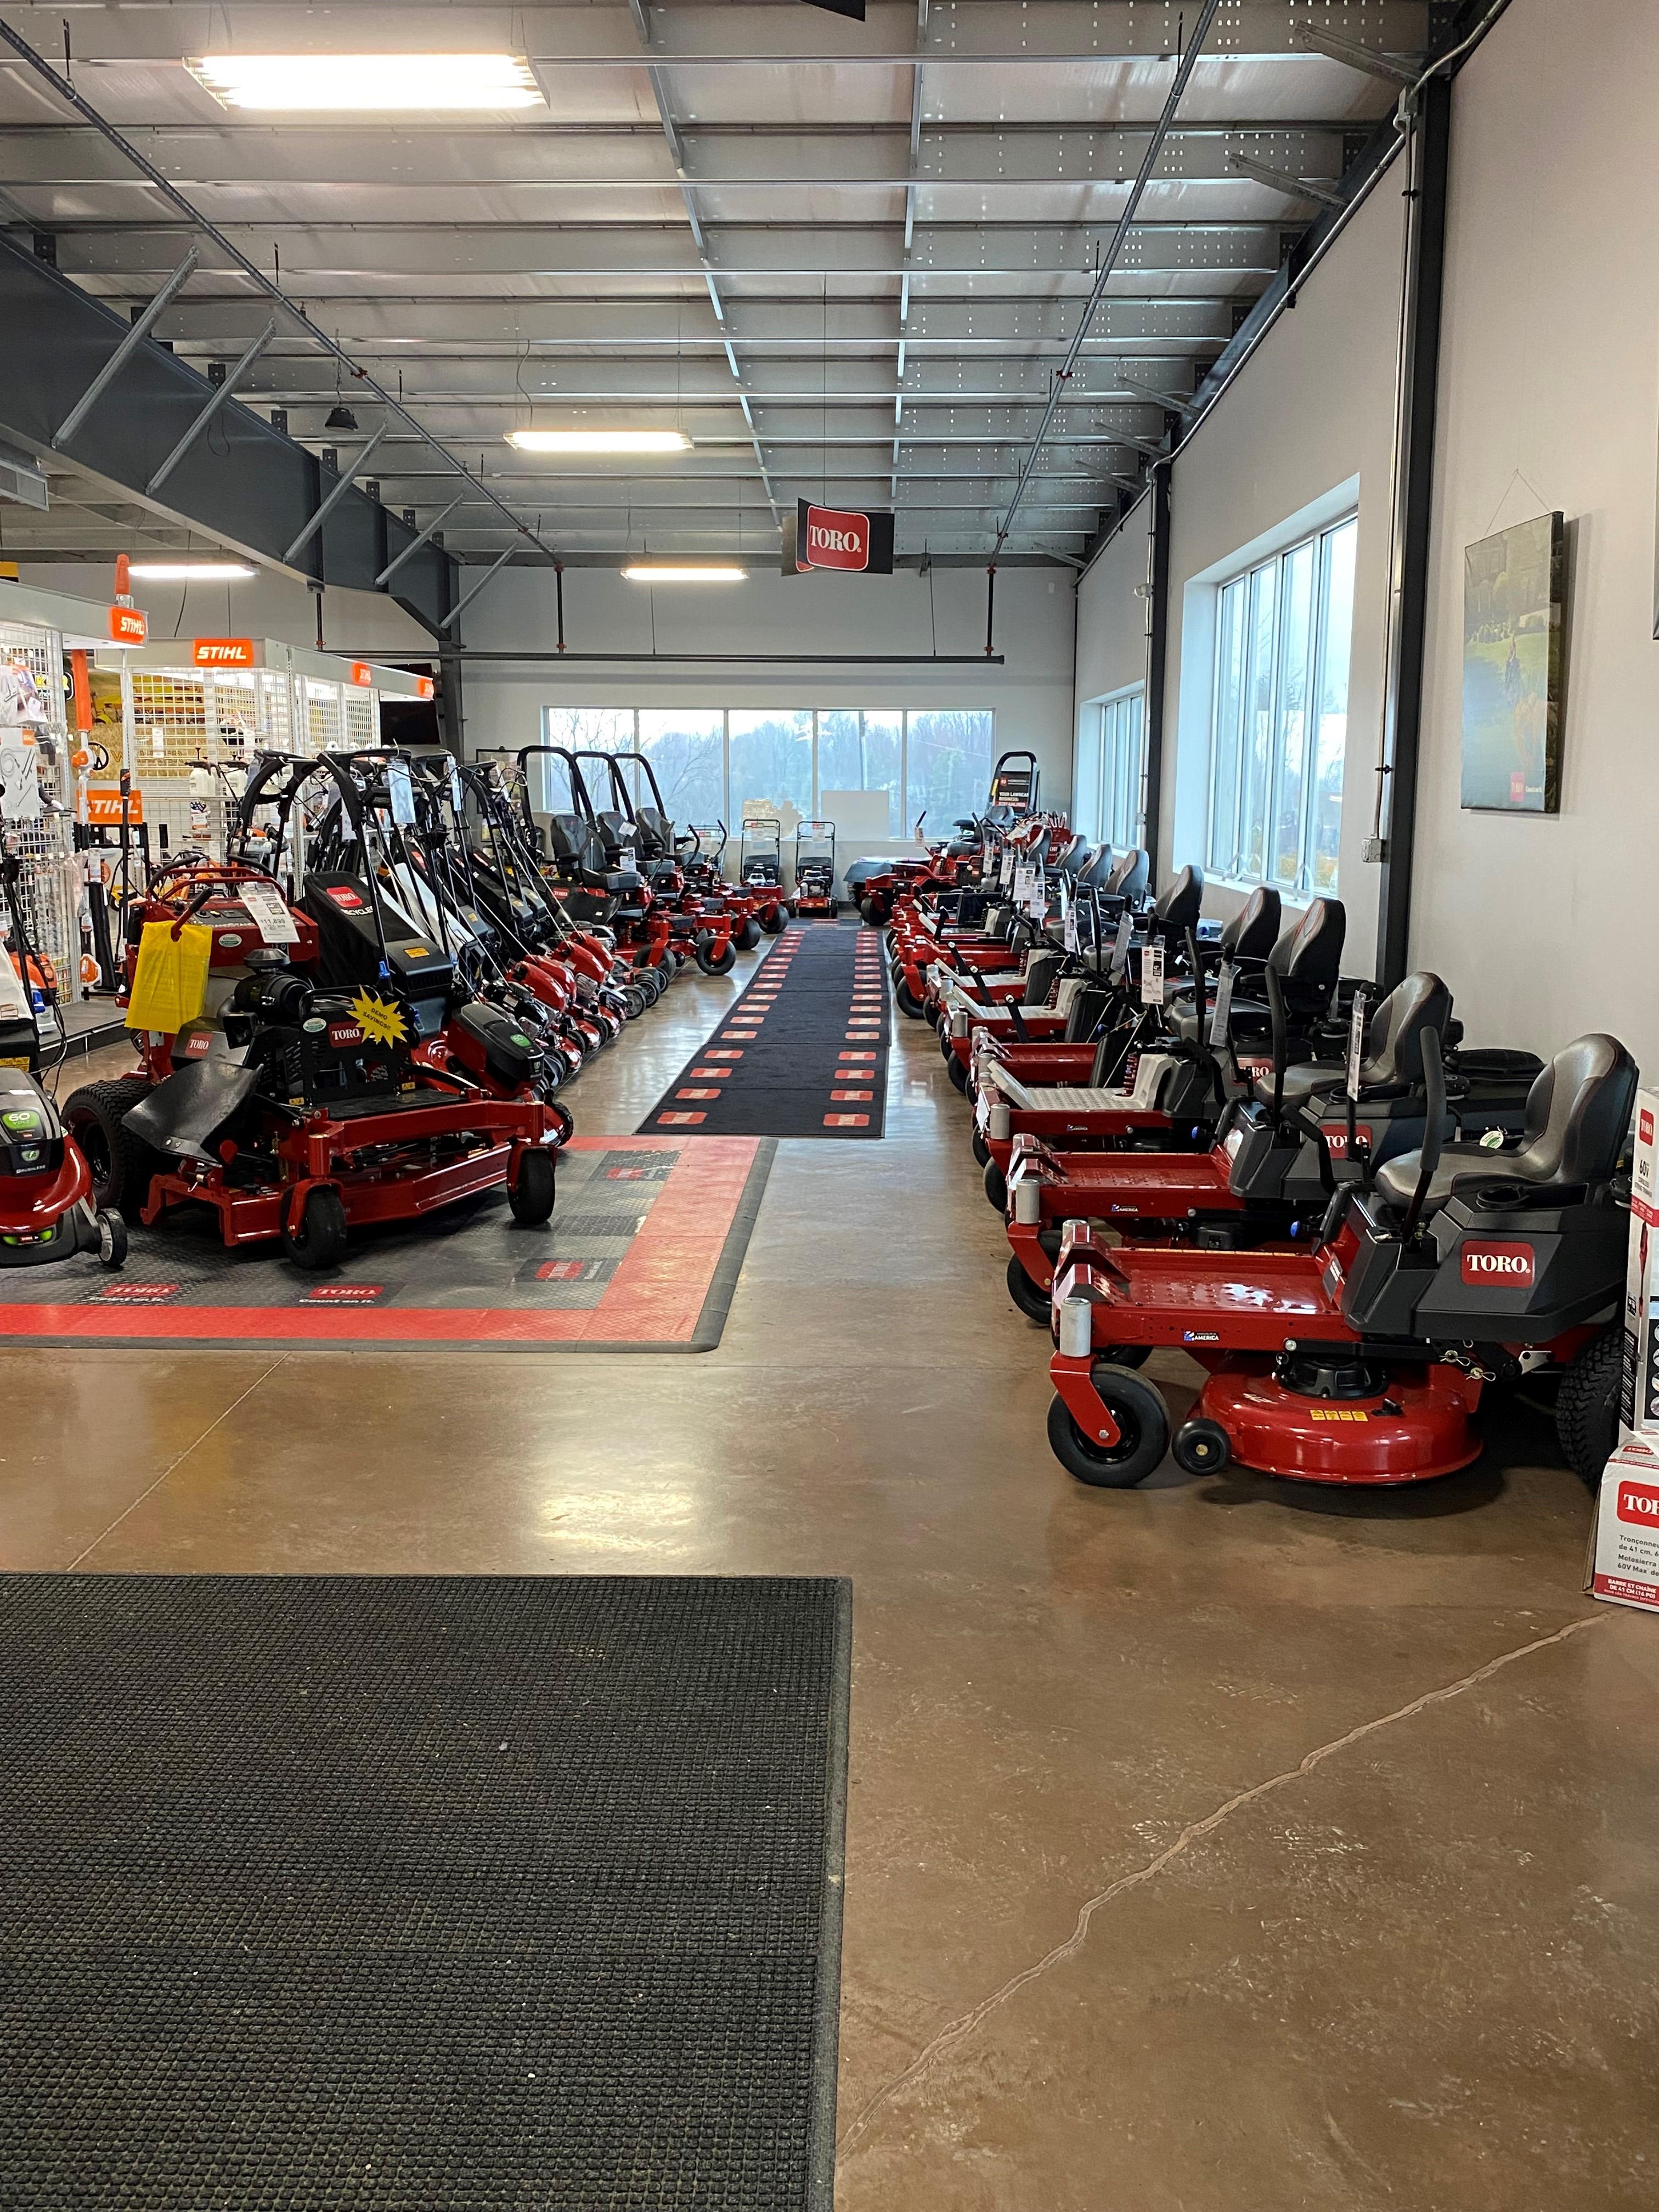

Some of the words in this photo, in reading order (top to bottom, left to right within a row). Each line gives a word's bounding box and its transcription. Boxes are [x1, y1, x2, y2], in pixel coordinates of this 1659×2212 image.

[810, 525, 861, 552] TORO
[120, 617, 144, 635] STIHL
[197, 646, 246, 659] STIHL
[84, 800, 139, 814] TIHL
[332, 892, 356, 902] TORO
[371, 1008, 387, 1020] DEMO
[332, 1028, 360, 1040] TORO
[190, 1039, 209, 1049] TORO
[8, 1112, 31, 1121] 60
[1325, 1135, 1368, 1148] TOO
[1467, 1255, 1530, 1273] TORO
[1618, 1554, 1656, 1567] Motosierra
[1607, 1578, 1627, 1587] BARRE
